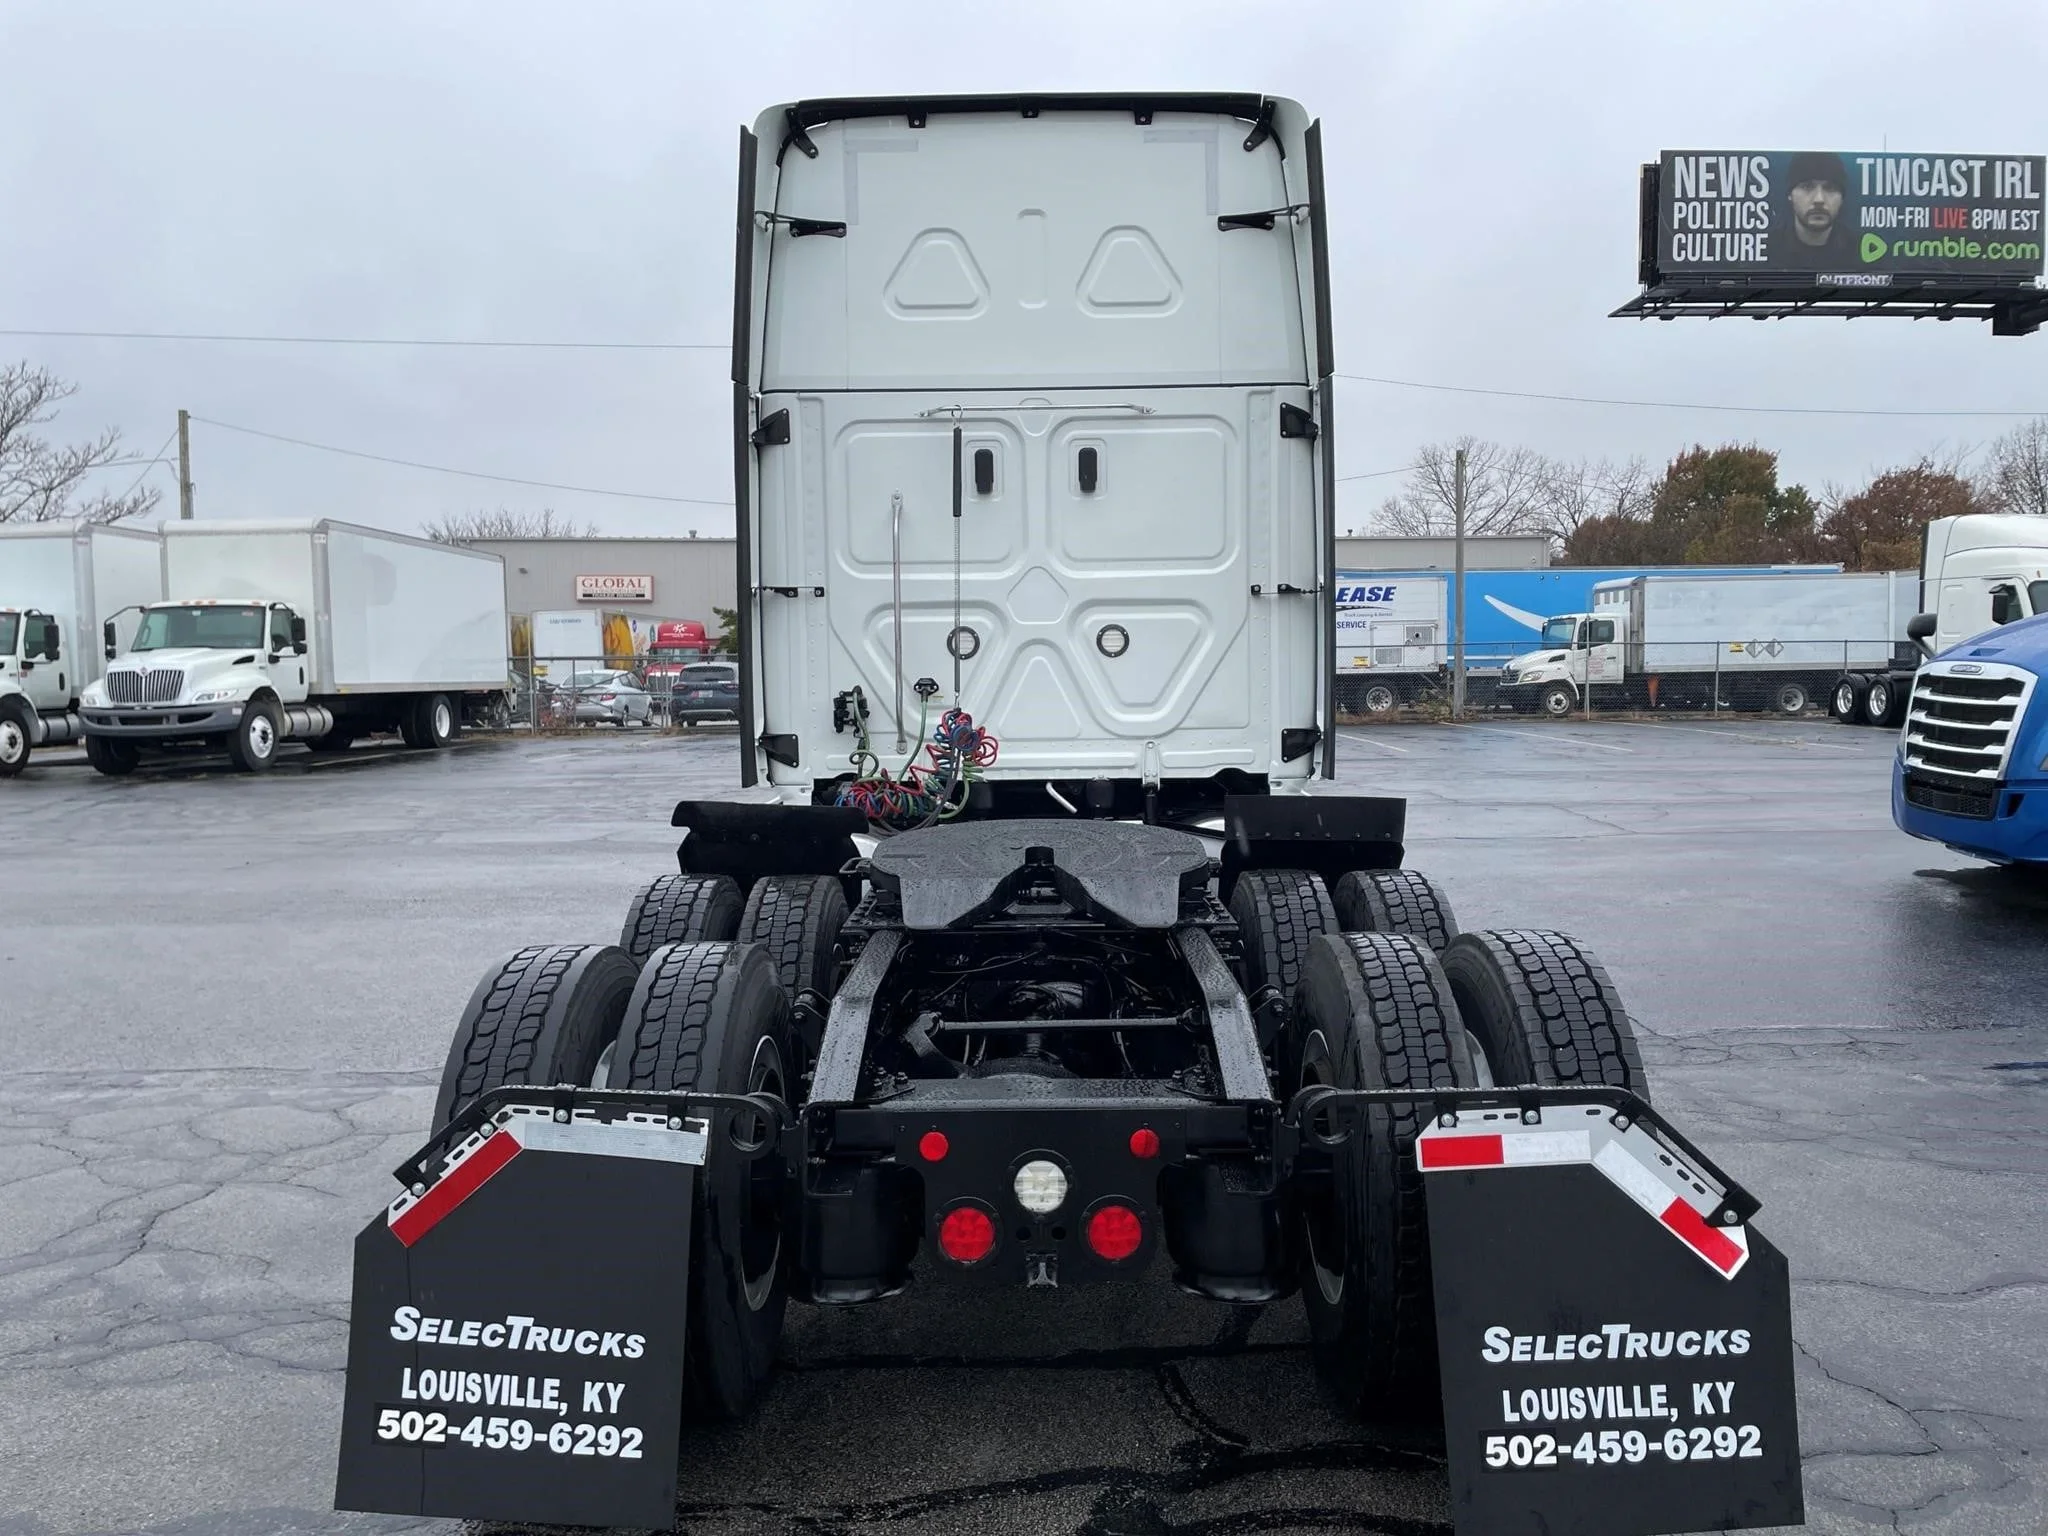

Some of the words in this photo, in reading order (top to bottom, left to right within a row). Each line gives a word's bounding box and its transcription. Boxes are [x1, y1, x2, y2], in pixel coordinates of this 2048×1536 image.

[1674, 156, 1770, 198] NEWS
[1856, 157, 1987, 198] TIMCAST
[1994, 160, 2040, 199] IRL
[1673, 201, 1769, 229] POLITICS
[1860, 206, 1930, 228] MON-FRI
[1934, 207, 1968, 229] LIVE
[1971, 208, 2007, 230] 8PM
[2010, 209, 2040, 231] EST
[1672, 233, 1769, 262] CULTURE
[1892, 236, 2040, 260] rumble.com
[582, 578, 646, 588] GLOBAL
[1336, 620, 1367, 629] SERVICE
[401, 1367, 568, 1416] LOUISVILLE,
[582, 1381, 625, 1414] KY
[1502, 1383, 1679, 1423] LOUISVILLE,
[1692, 1381, 1735, 1415] KY
[377, 1409, 644, 1459] 502-459-6292
[1485, 1424, 1763, 1467] 502-459-6292
